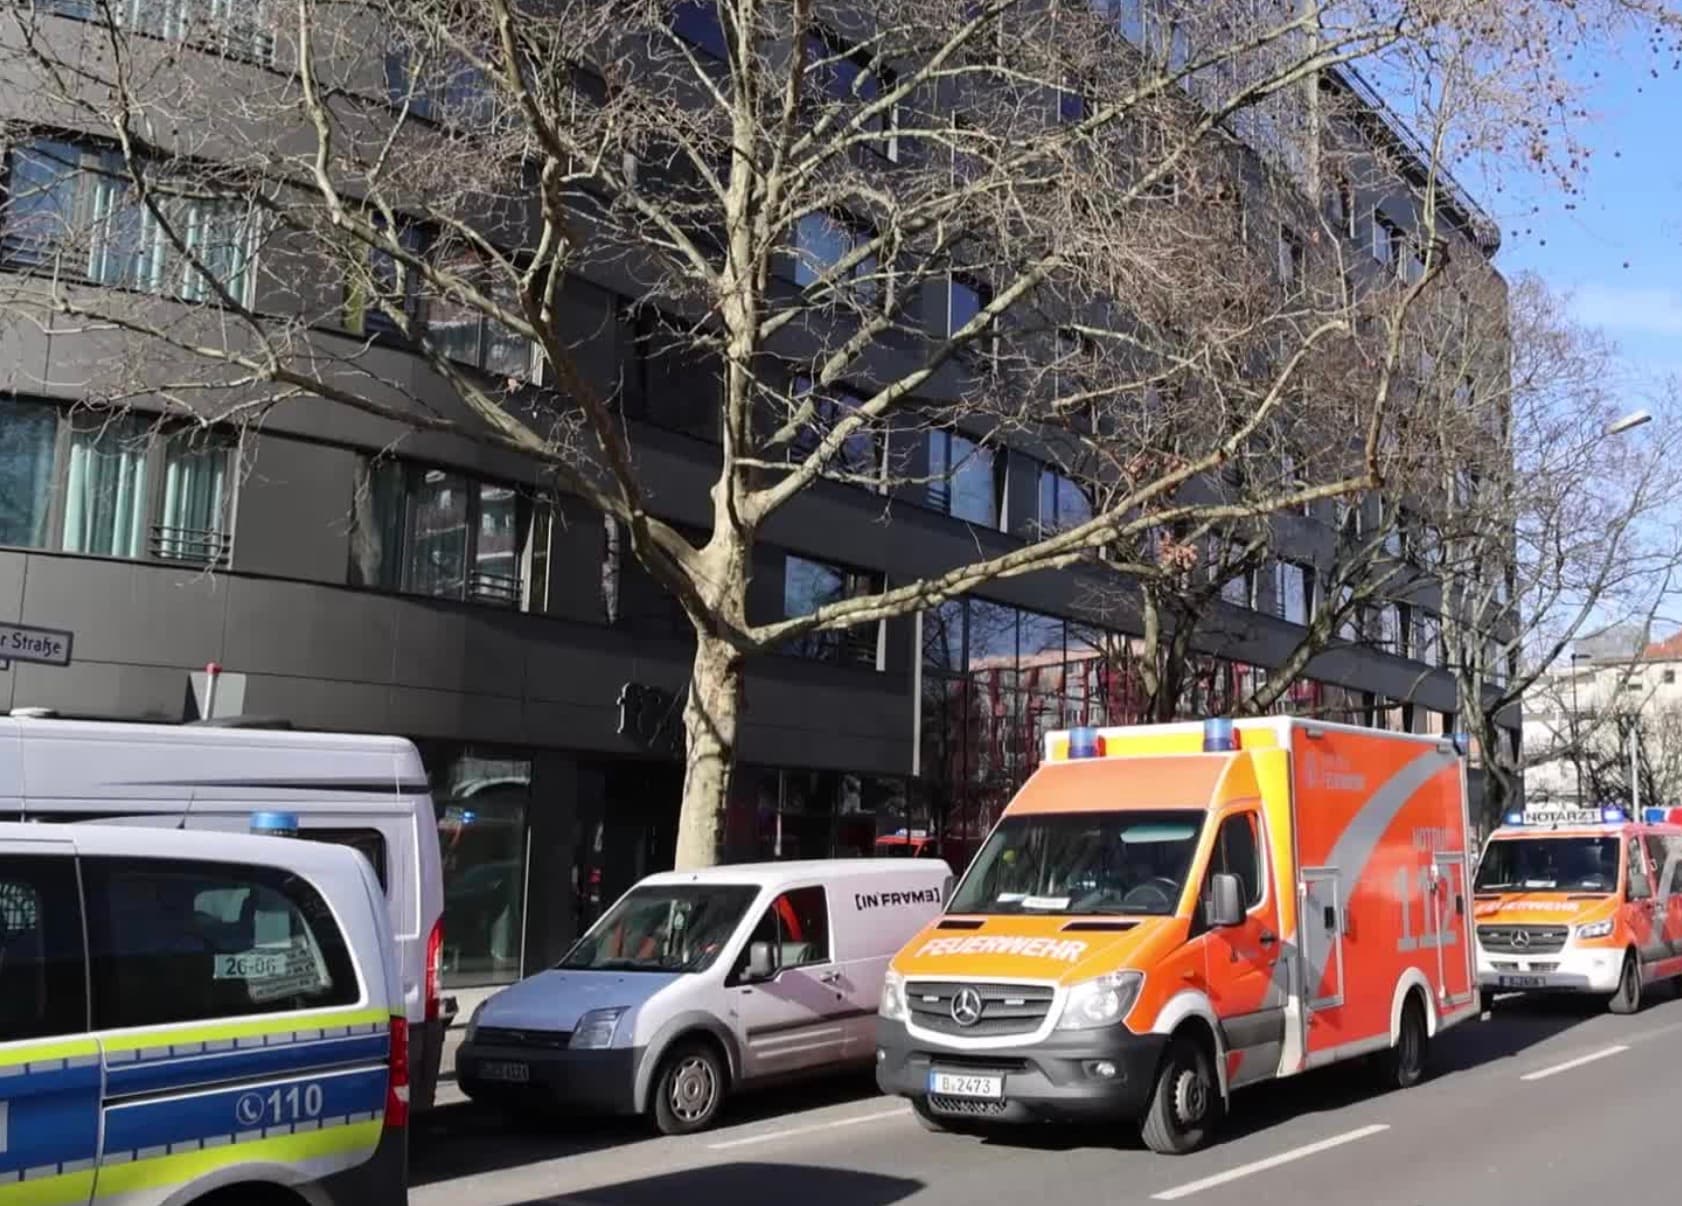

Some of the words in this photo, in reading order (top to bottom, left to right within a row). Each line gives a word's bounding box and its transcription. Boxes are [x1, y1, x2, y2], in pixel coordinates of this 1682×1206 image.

[12, 631, 62, 657] Straße
[1526, 810, 1596, 822] NOTARZT
[915, 935, 1088, 962] FEUERWEHR
[225, 957, 276, 976] 26-06
[267, 1083, 323, 1123] 110
